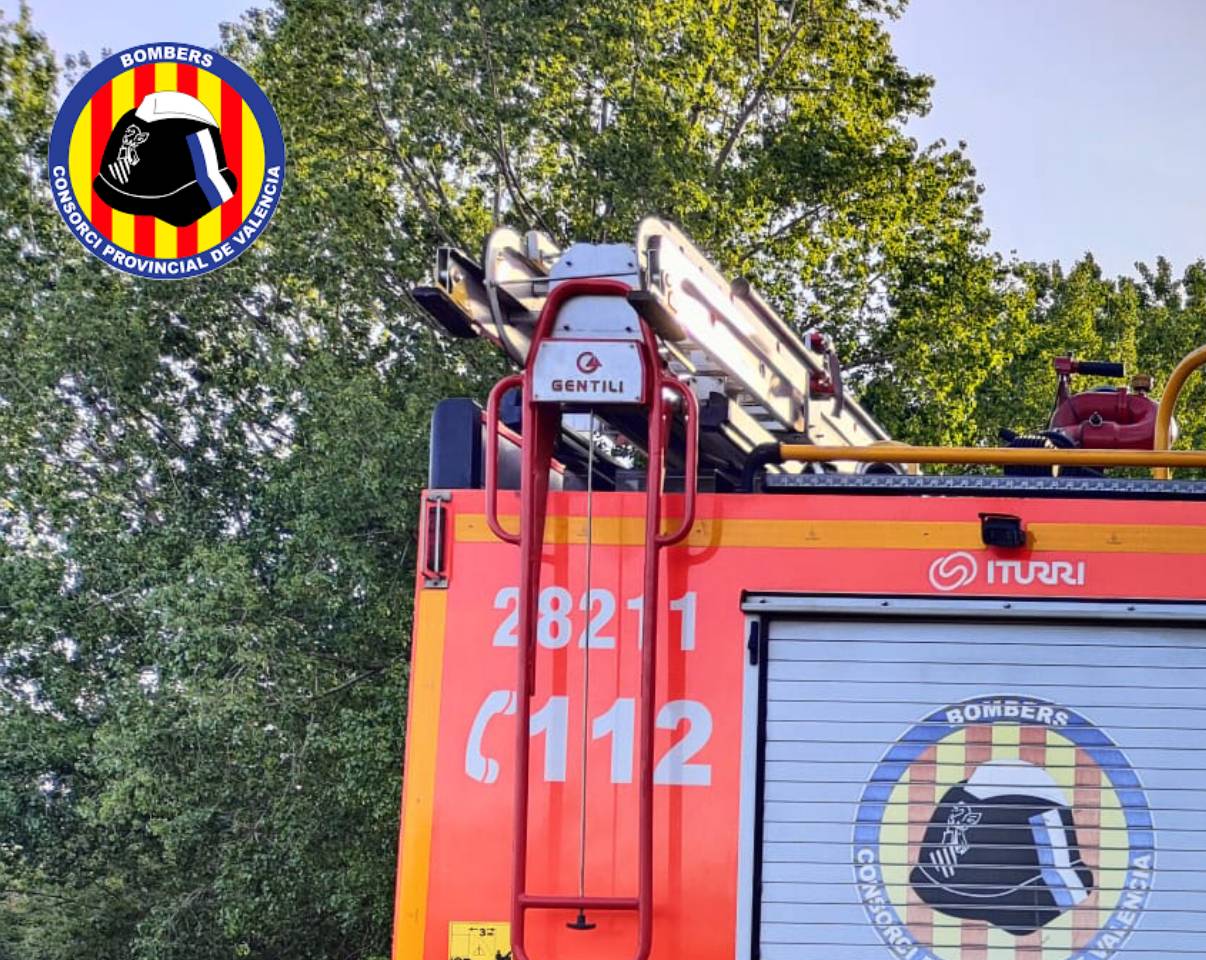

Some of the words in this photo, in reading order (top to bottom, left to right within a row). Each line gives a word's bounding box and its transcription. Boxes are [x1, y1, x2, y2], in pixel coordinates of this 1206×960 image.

[551, 379, 625, 393] GENTILI
[987, 559, 1086, 585] ITURRI
[492, 586, 698, 650] 28211
[946, 700, 1070, 726] BOMBERS
[529, 695, 713, 786] 112
[857, 848, 918, 960] CONSORCI
[1088, 854, 1152, 959] VALENCIA
